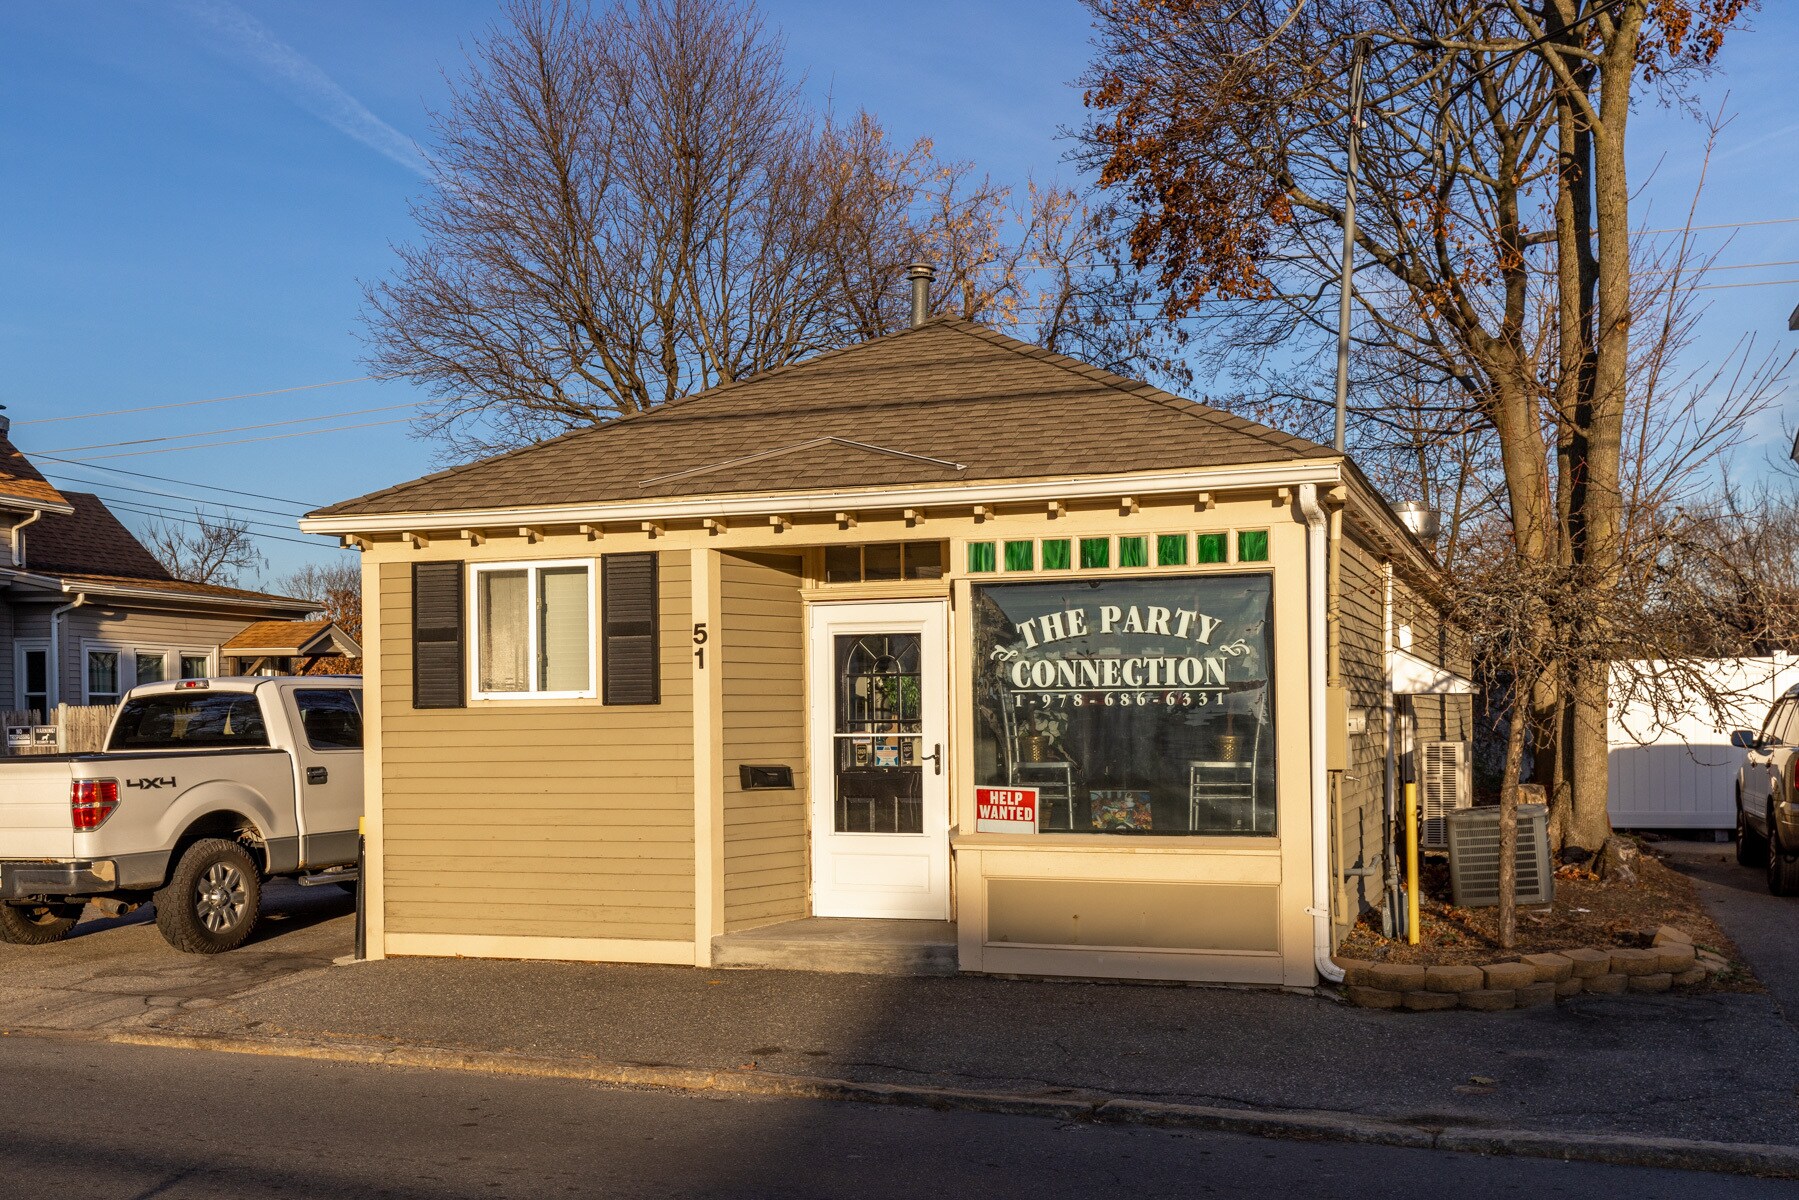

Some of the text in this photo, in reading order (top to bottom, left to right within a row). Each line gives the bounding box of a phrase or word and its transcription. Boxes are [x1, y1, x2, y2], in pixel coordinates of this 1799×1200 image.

[1016, 605, 1222, 649] THE PARTY
[1011, 656, 1228, 688] CONNECTION
[1015, 692, 1224, 708] 1-978-686-6331
[990, 791, 1023, 806] HELP
[979, 805, 1033, 821] WANTED
